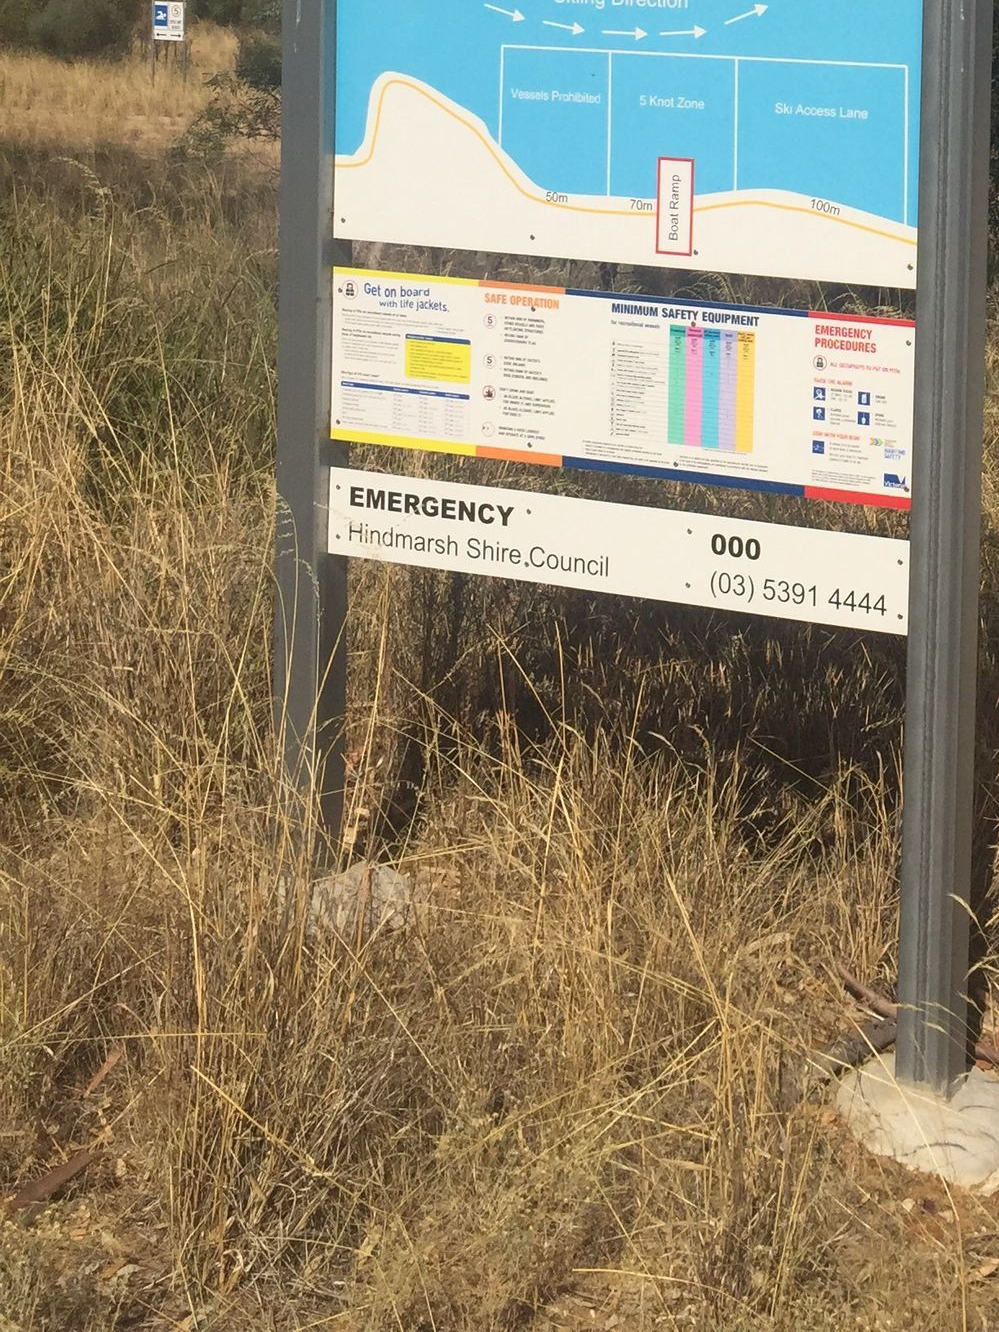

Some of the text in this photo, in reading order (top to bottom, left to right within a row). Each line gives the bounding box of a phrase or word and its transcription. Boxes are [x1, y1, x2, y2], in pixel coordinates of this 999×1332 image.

[510, 88, 601, 105] Vessels Prohibited
[639, 96, 705, 110] 5 Knot Zone
[774, 103, 868, 120] Ski Access Lane
[545, 191, 568, 204] 50m
[630, 199, 653, 212] 70m
[669, 174, 681, 242] Boat Ramp
[809, 198, 841, 216] 100m
[364, 282, 430, 298] Get on board
[379, 300, 398, 308] with
[400, 299, 414, 309] life
[416, 299, 450, 313] jackets.
[484, 292, 560, 309] SAFE OPERATION
[611, 303, 760, 327] MINIMUM SAFETY EQUIPMENT
[815, 325, 872, 340] EMERGENCY
[815, 337, 877, 353] PROCEDURES
[349, 486, 515, 527] EMERGENCY
[349, 524, 609, 577] Hindmarsh Shire Council
[711, 533, 762, 561] 000
[710, 571, 888, 617] (03) 5391 4444
